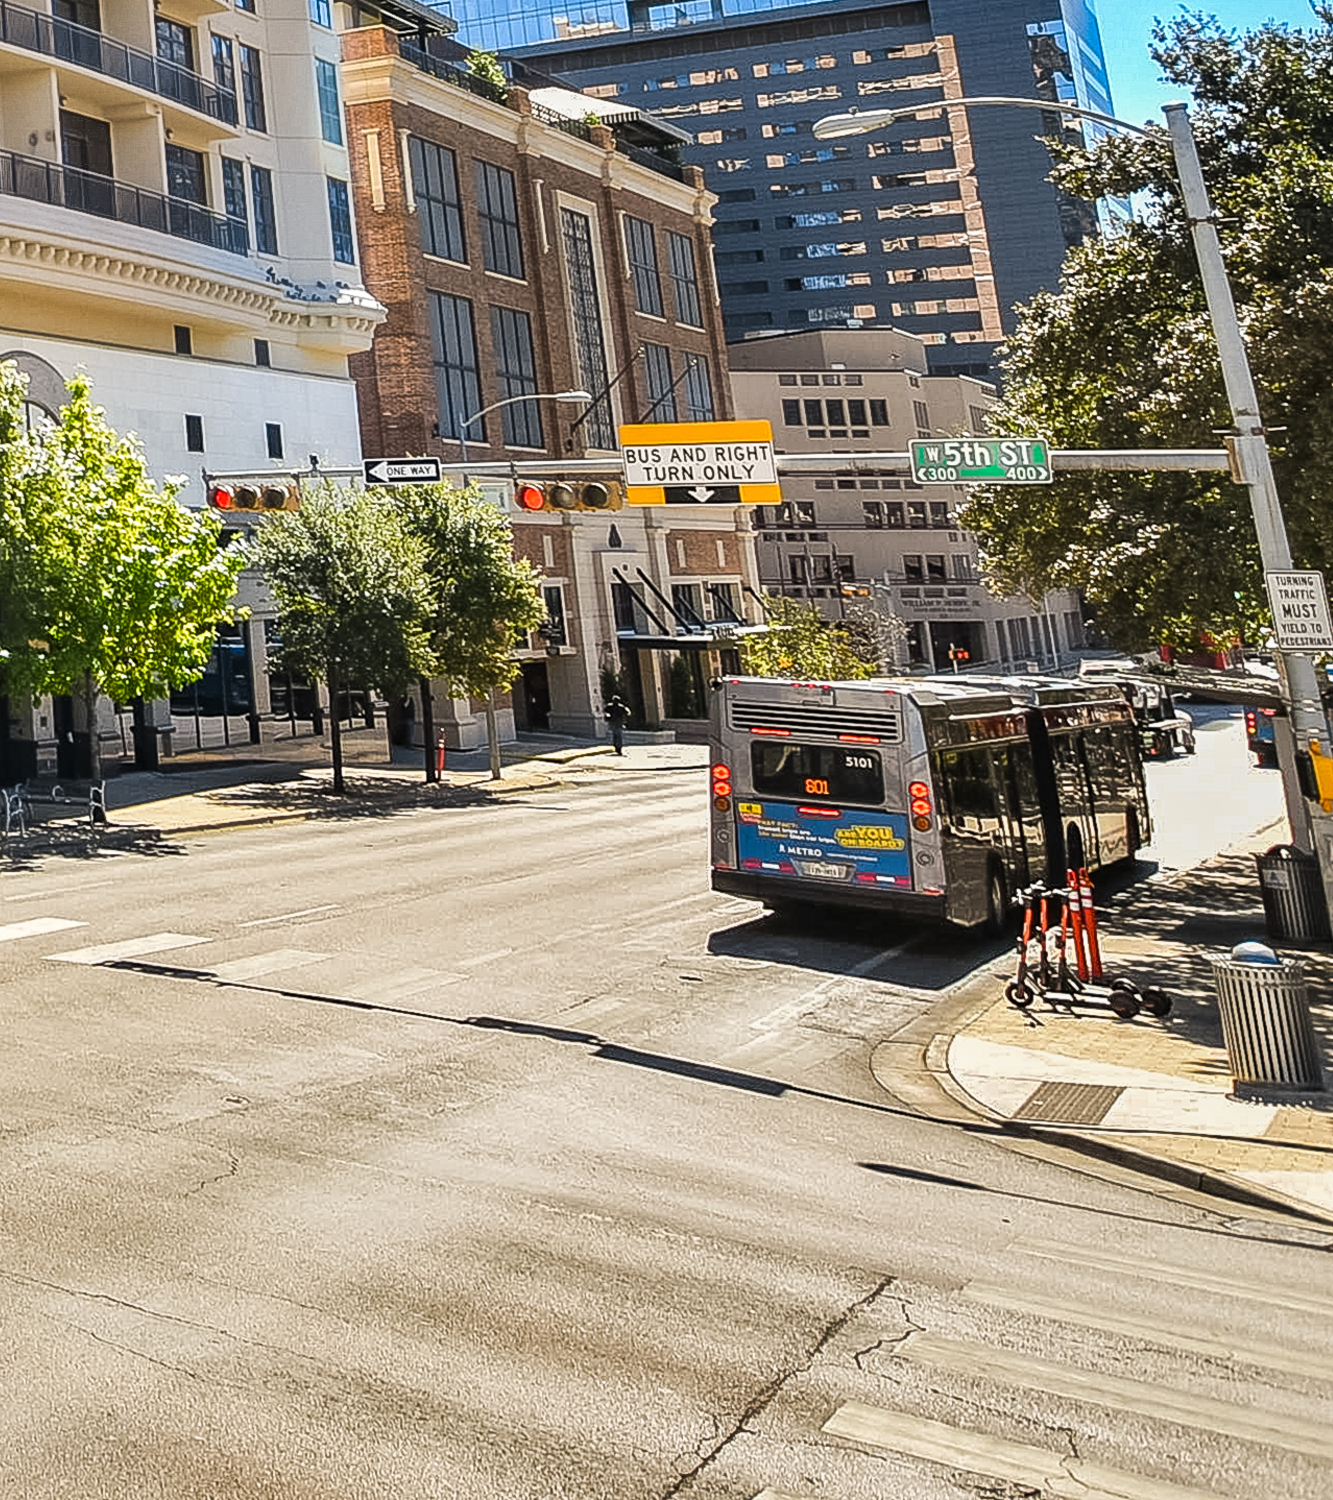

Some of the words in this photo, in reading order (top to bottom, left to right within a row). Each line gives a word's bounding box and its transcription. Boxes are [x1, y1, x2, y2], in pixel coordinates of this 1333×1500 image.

[626, 449, 661, 464] BUS
[670, 447, 706, 462] AND
[715, 446, 768, 461] RIGHT
[926, 446, 939, 463] W
[944, 442, 991, 466] 5th
[1000, 442, 1031, 466] ST
[386, 466, 408, 476] ONE
[410, 466, 431, 475] WAY
[643, 466, 694, 481] TURN
[703, 465, 754, 480] ONLY
[928, 467, 956, 480] 300
[1005, 467, 1036, 480] 400
[1275, 576, 1314, 587] TURNING
[1278, 589, 1315, 600] TRAFFIC
[1281, 604, 1317, 618] MUST
[1281, 623, 1307, 634] YIELD
[1310, 623, 1322, 634] TO
[1280, 637, 1332, 646] PEDESTRIANS
[845, 756, 873, 768] 5101
[855, 827, 890, 839] YOU
[787, 845, 822, 857] METRO
